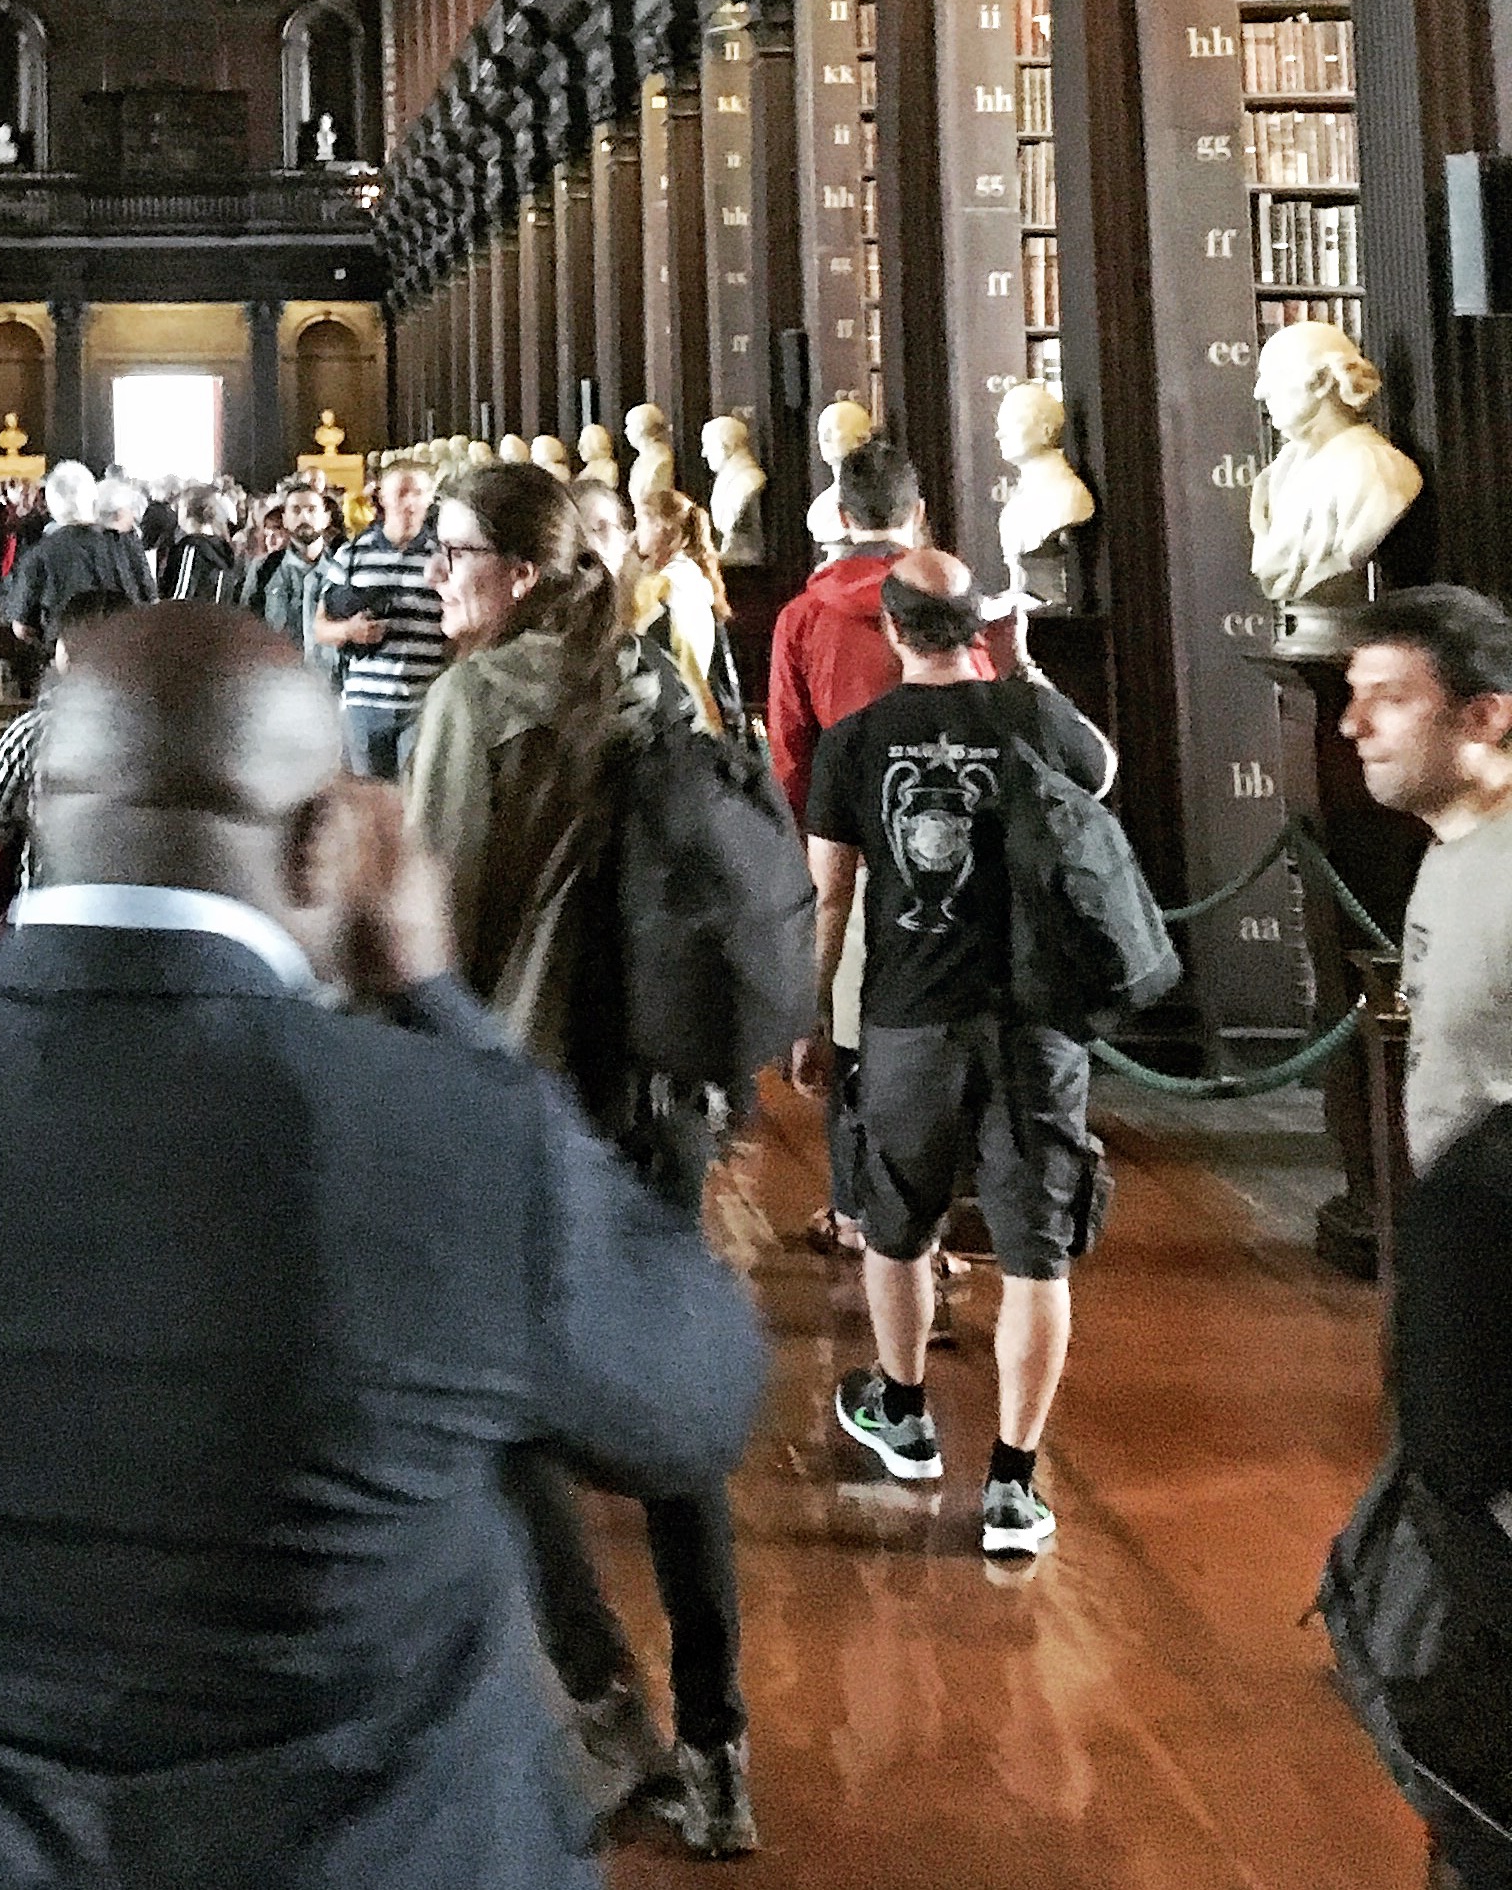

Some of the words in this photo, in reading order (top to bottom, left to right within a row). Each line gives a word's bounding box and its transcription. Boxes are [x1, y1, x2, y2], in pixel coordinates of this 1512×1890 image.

[979, 3, 1001, 29] ii
[1187, 26, 1234, 58] hh
[975, 85, 1015, 112] hh
[1196, 134, 1232, 162] gg
[823, 185, 855, 209] hh
[1205, 227, 1239, 258] ff
[987, 270, 1014, 296] ff
[1207, 340, 1251, 366] ee
[1211, 455, 1256, 489] dd
[1231, 761, 1274, 799] bb
[1239, 914, 1281, 940] aa
